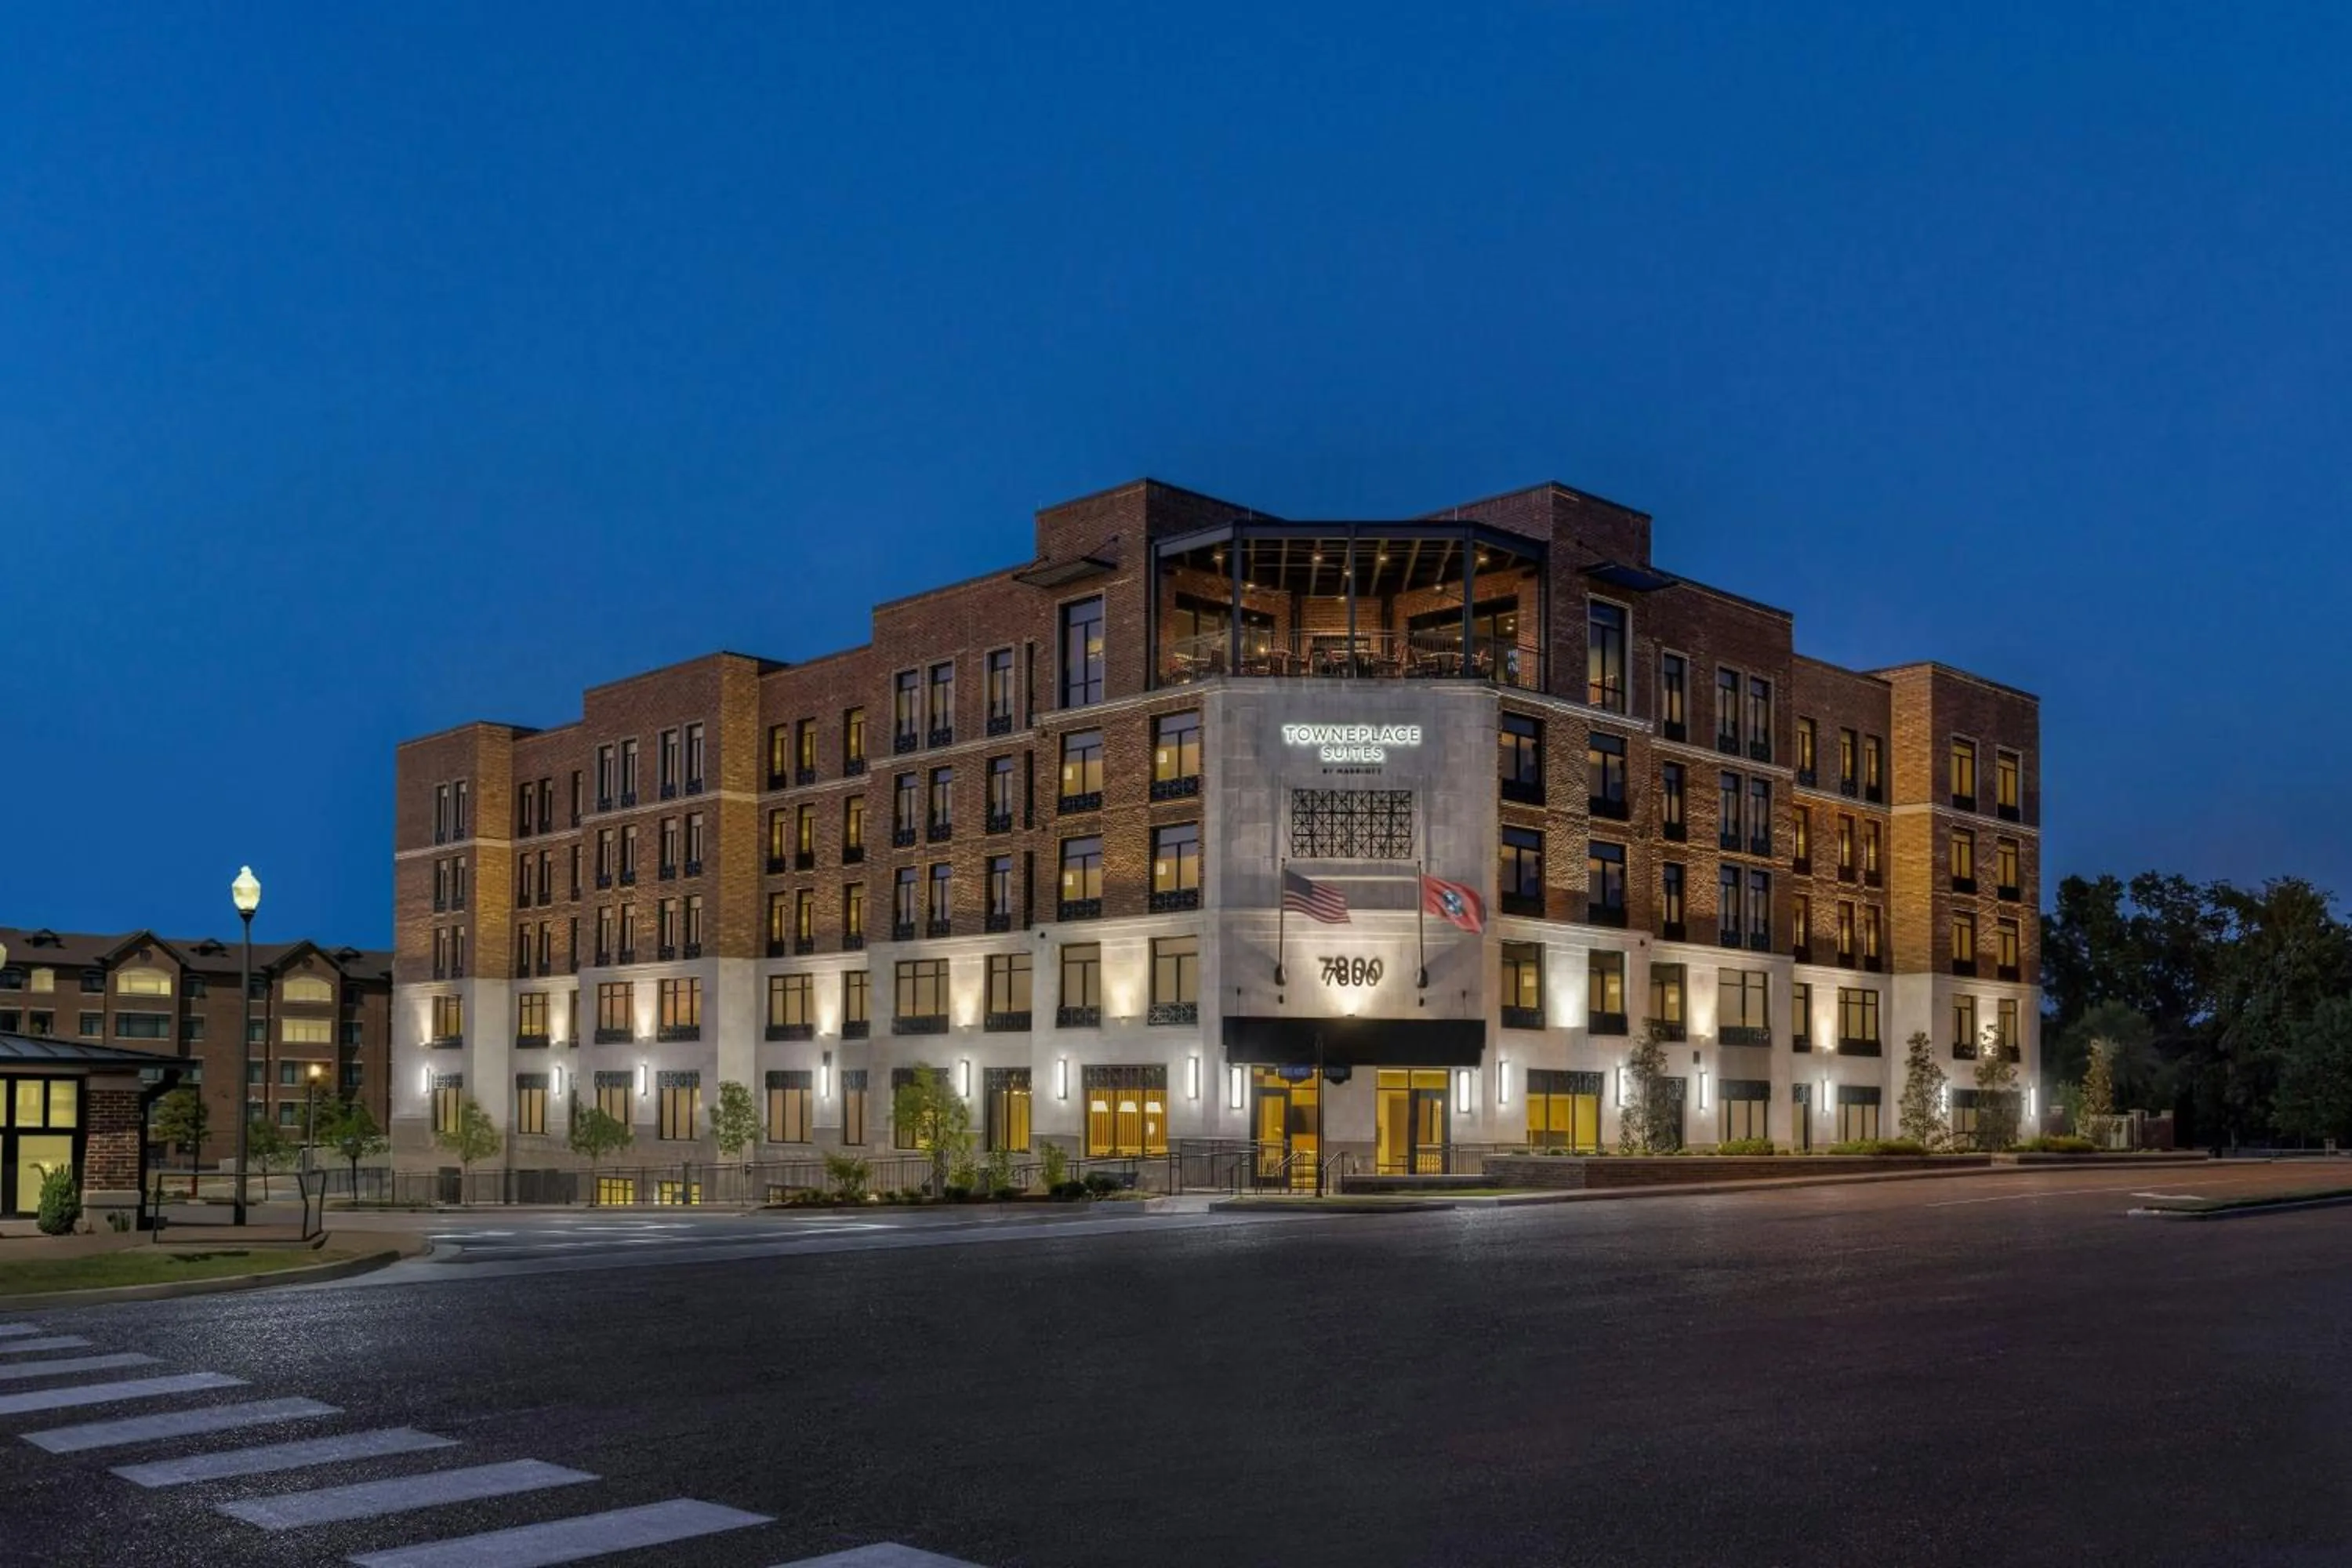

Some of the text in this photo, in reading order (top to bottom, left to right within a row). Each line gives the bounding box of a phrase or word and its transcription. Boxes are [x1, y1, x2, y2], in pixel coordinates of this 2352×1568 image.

[1284, 725, 1420, 742] TOWNEPLACE
[1322, 746, 1382, 759] SUITES
[1319, 959, 1381, 986] 7800
